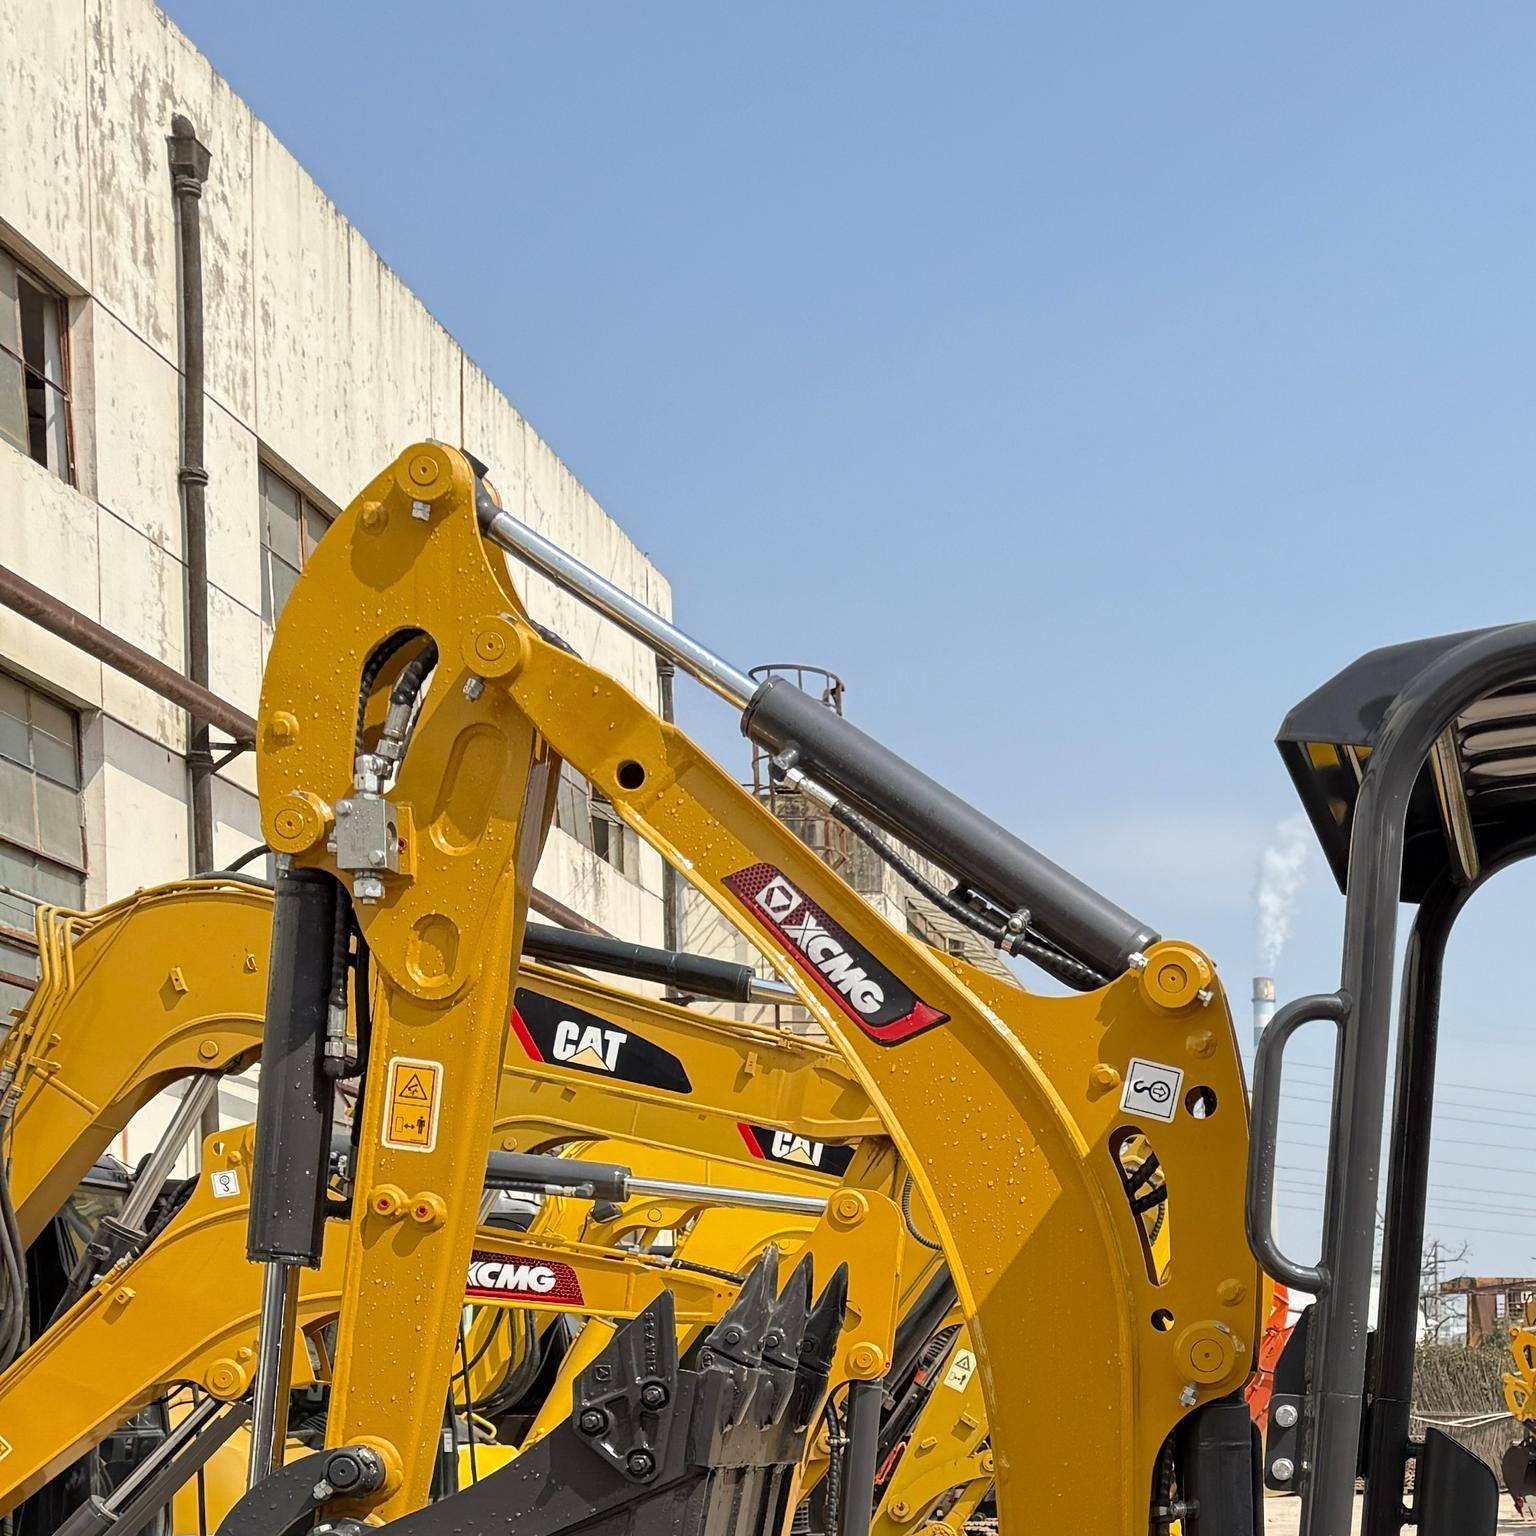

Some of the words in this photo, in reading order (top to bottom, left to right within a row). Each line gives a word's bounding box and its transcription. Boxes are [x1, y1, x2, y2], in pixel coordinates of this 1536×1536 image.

[781, 911, 884, 1014] XCMG
[553, 1020, 627, 1072] CAT
[771, 1130, 824, 1167] CAT
